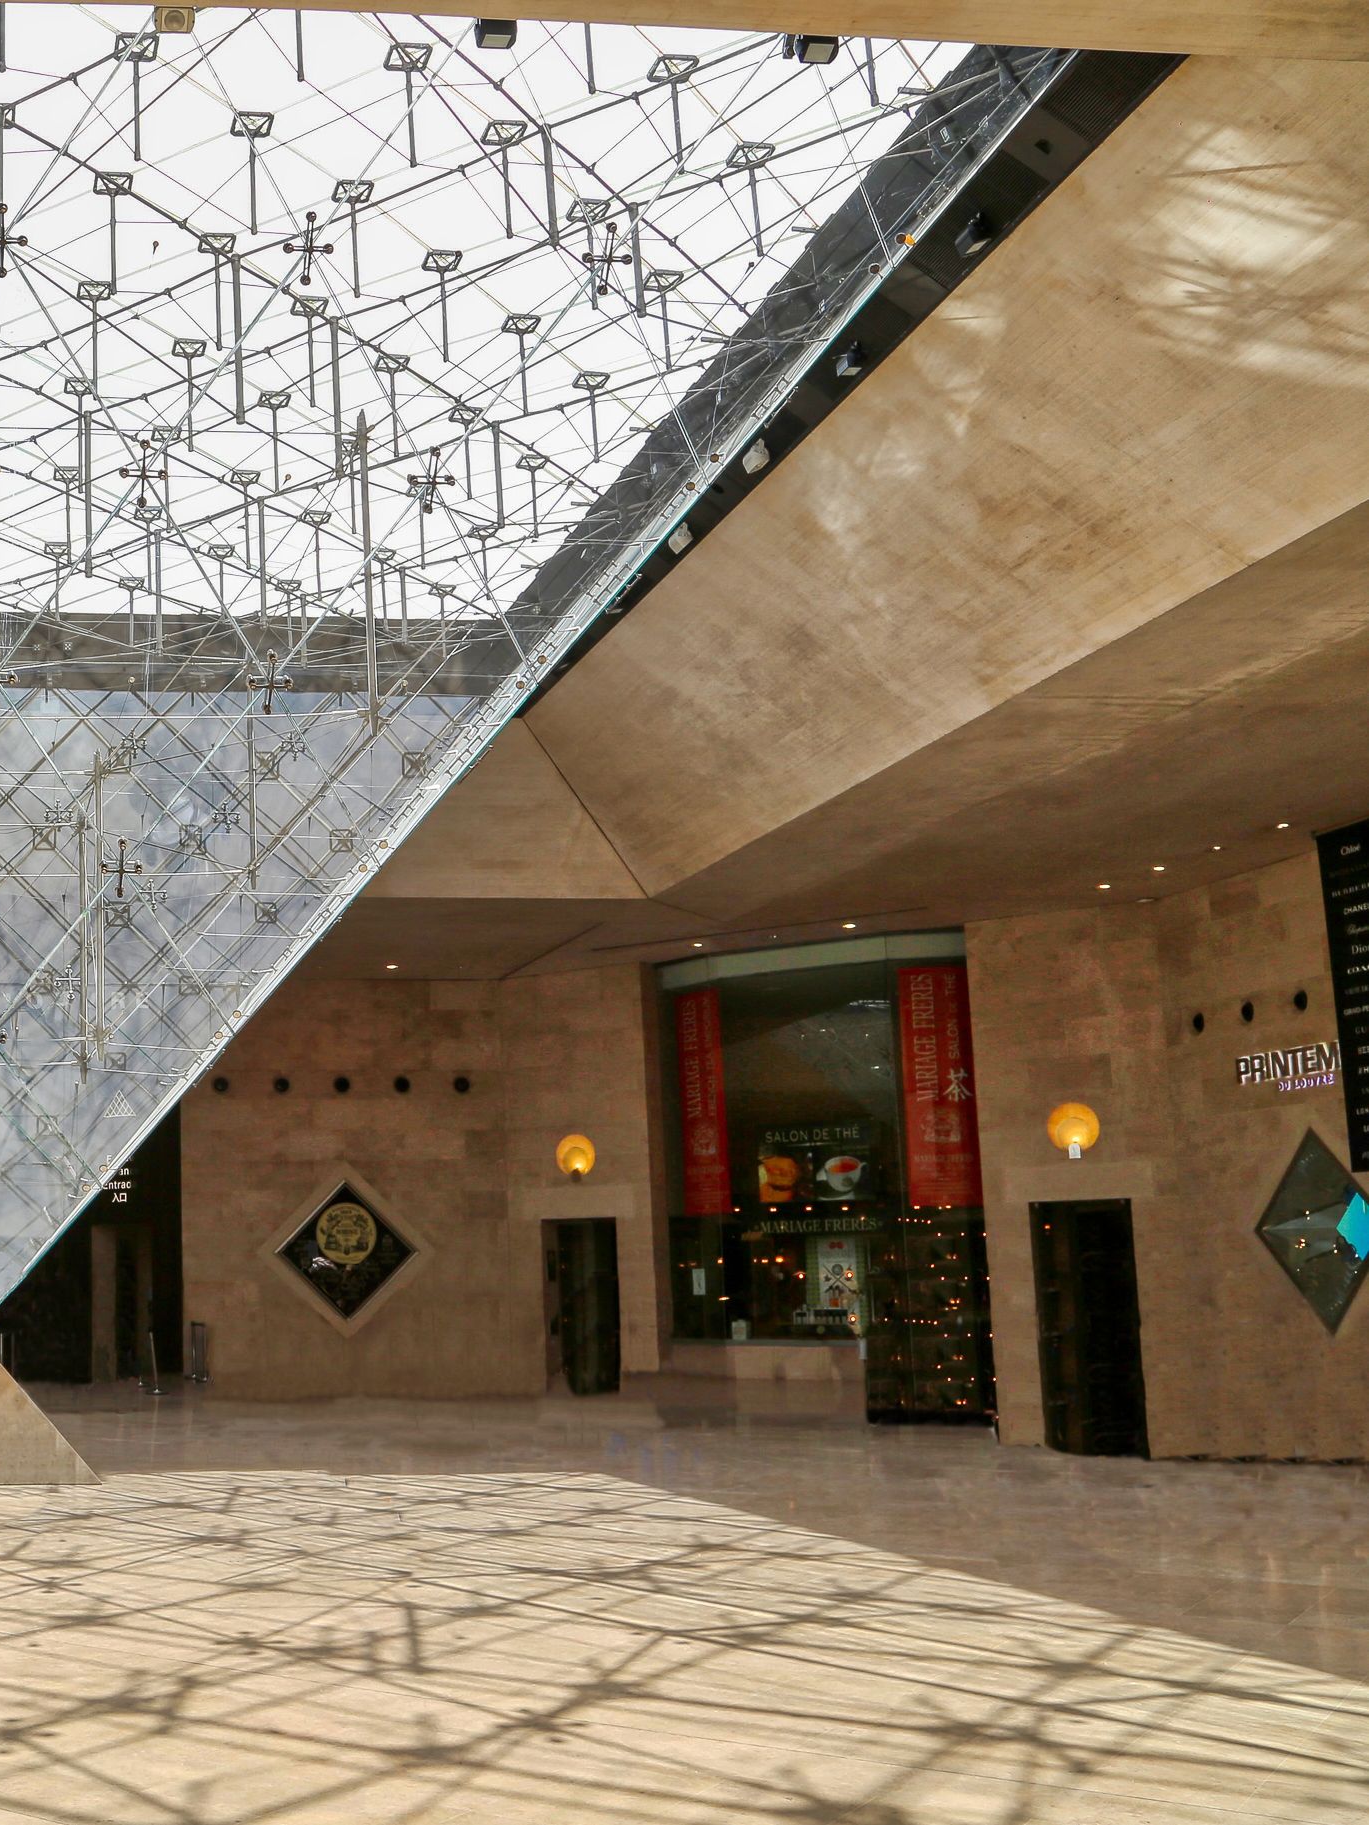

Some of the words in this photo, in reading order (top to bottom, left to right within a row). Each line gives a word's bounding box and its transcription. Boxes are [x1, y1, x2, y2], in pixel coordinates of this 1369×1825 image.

[946, 1019, 960, 1060] SALON
[914, 1035, 939, 1103] MARIAGE
[1235, 1040, 1341, 1086] PRINTEM
[685, 1055, 702, 1119] MARIAGE
[943, 1067, 975, 1102] 茶
[1277, 1079, 1292, 1092] DU
[765, 1130, 809, 1143] SALON
[813, 1128, 830, 1140] DE
[834, 1124, 860, 1139] THÉ
[112, 1192, 128, 1203] 入口
[761, 1218, 822, 1234] MARIAGE
